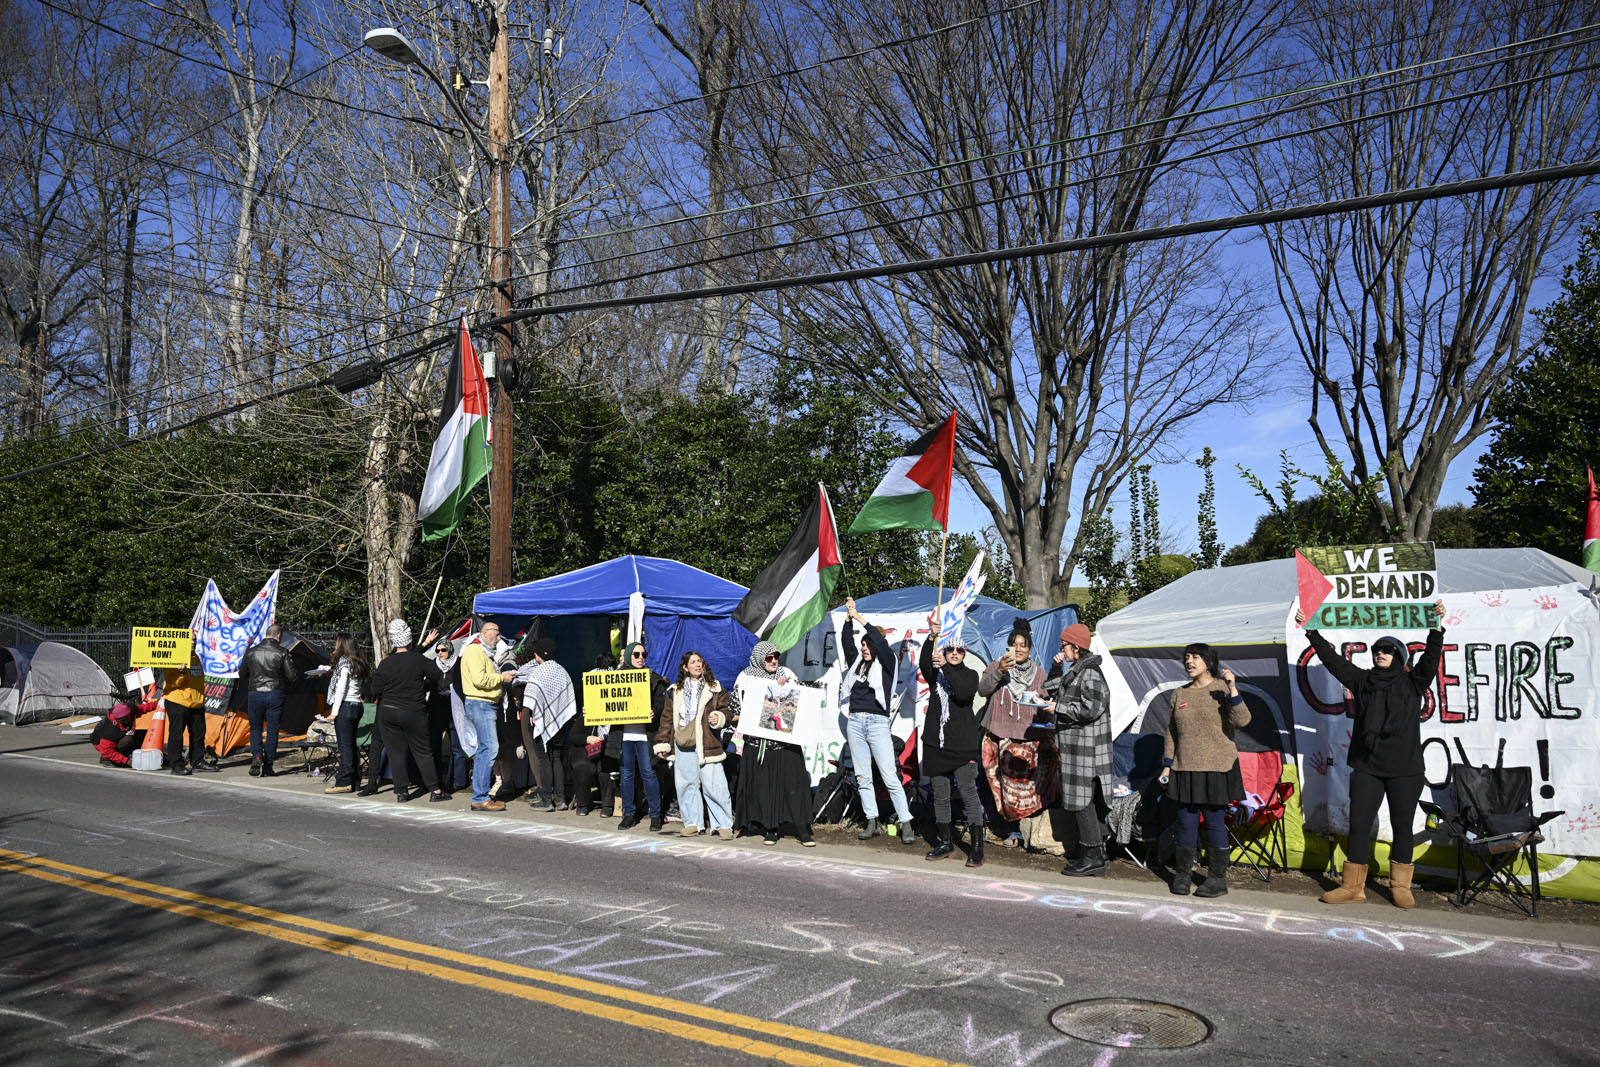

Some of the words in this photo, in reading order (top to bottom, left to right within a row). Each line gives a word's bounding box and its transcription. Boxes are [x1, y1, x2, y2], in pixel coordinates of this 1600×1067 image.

[1343, 547, 1398, 572] WE
[1336, 573, 1435, 599] DEMAND
[1321, 605, 1438, 629] CEASEFIRE
[135, 629, 151, 638] FULL
[153, 630, 190, 639] CEASEFIRE
[148, 640, 156, 648] IN
[158, 640, 177, 648] GAZA
[151, 650, 172, 658] NOW!
[585, 675, 603, 686] FULL
[605, 672, 647, 684] CEASEFIRE
[600, 688, 609, 699] IN
[611, 687, 633, 698] GAZA
[605, 701, 628, 712] NOW!
[579, 899, 725, 938] the
